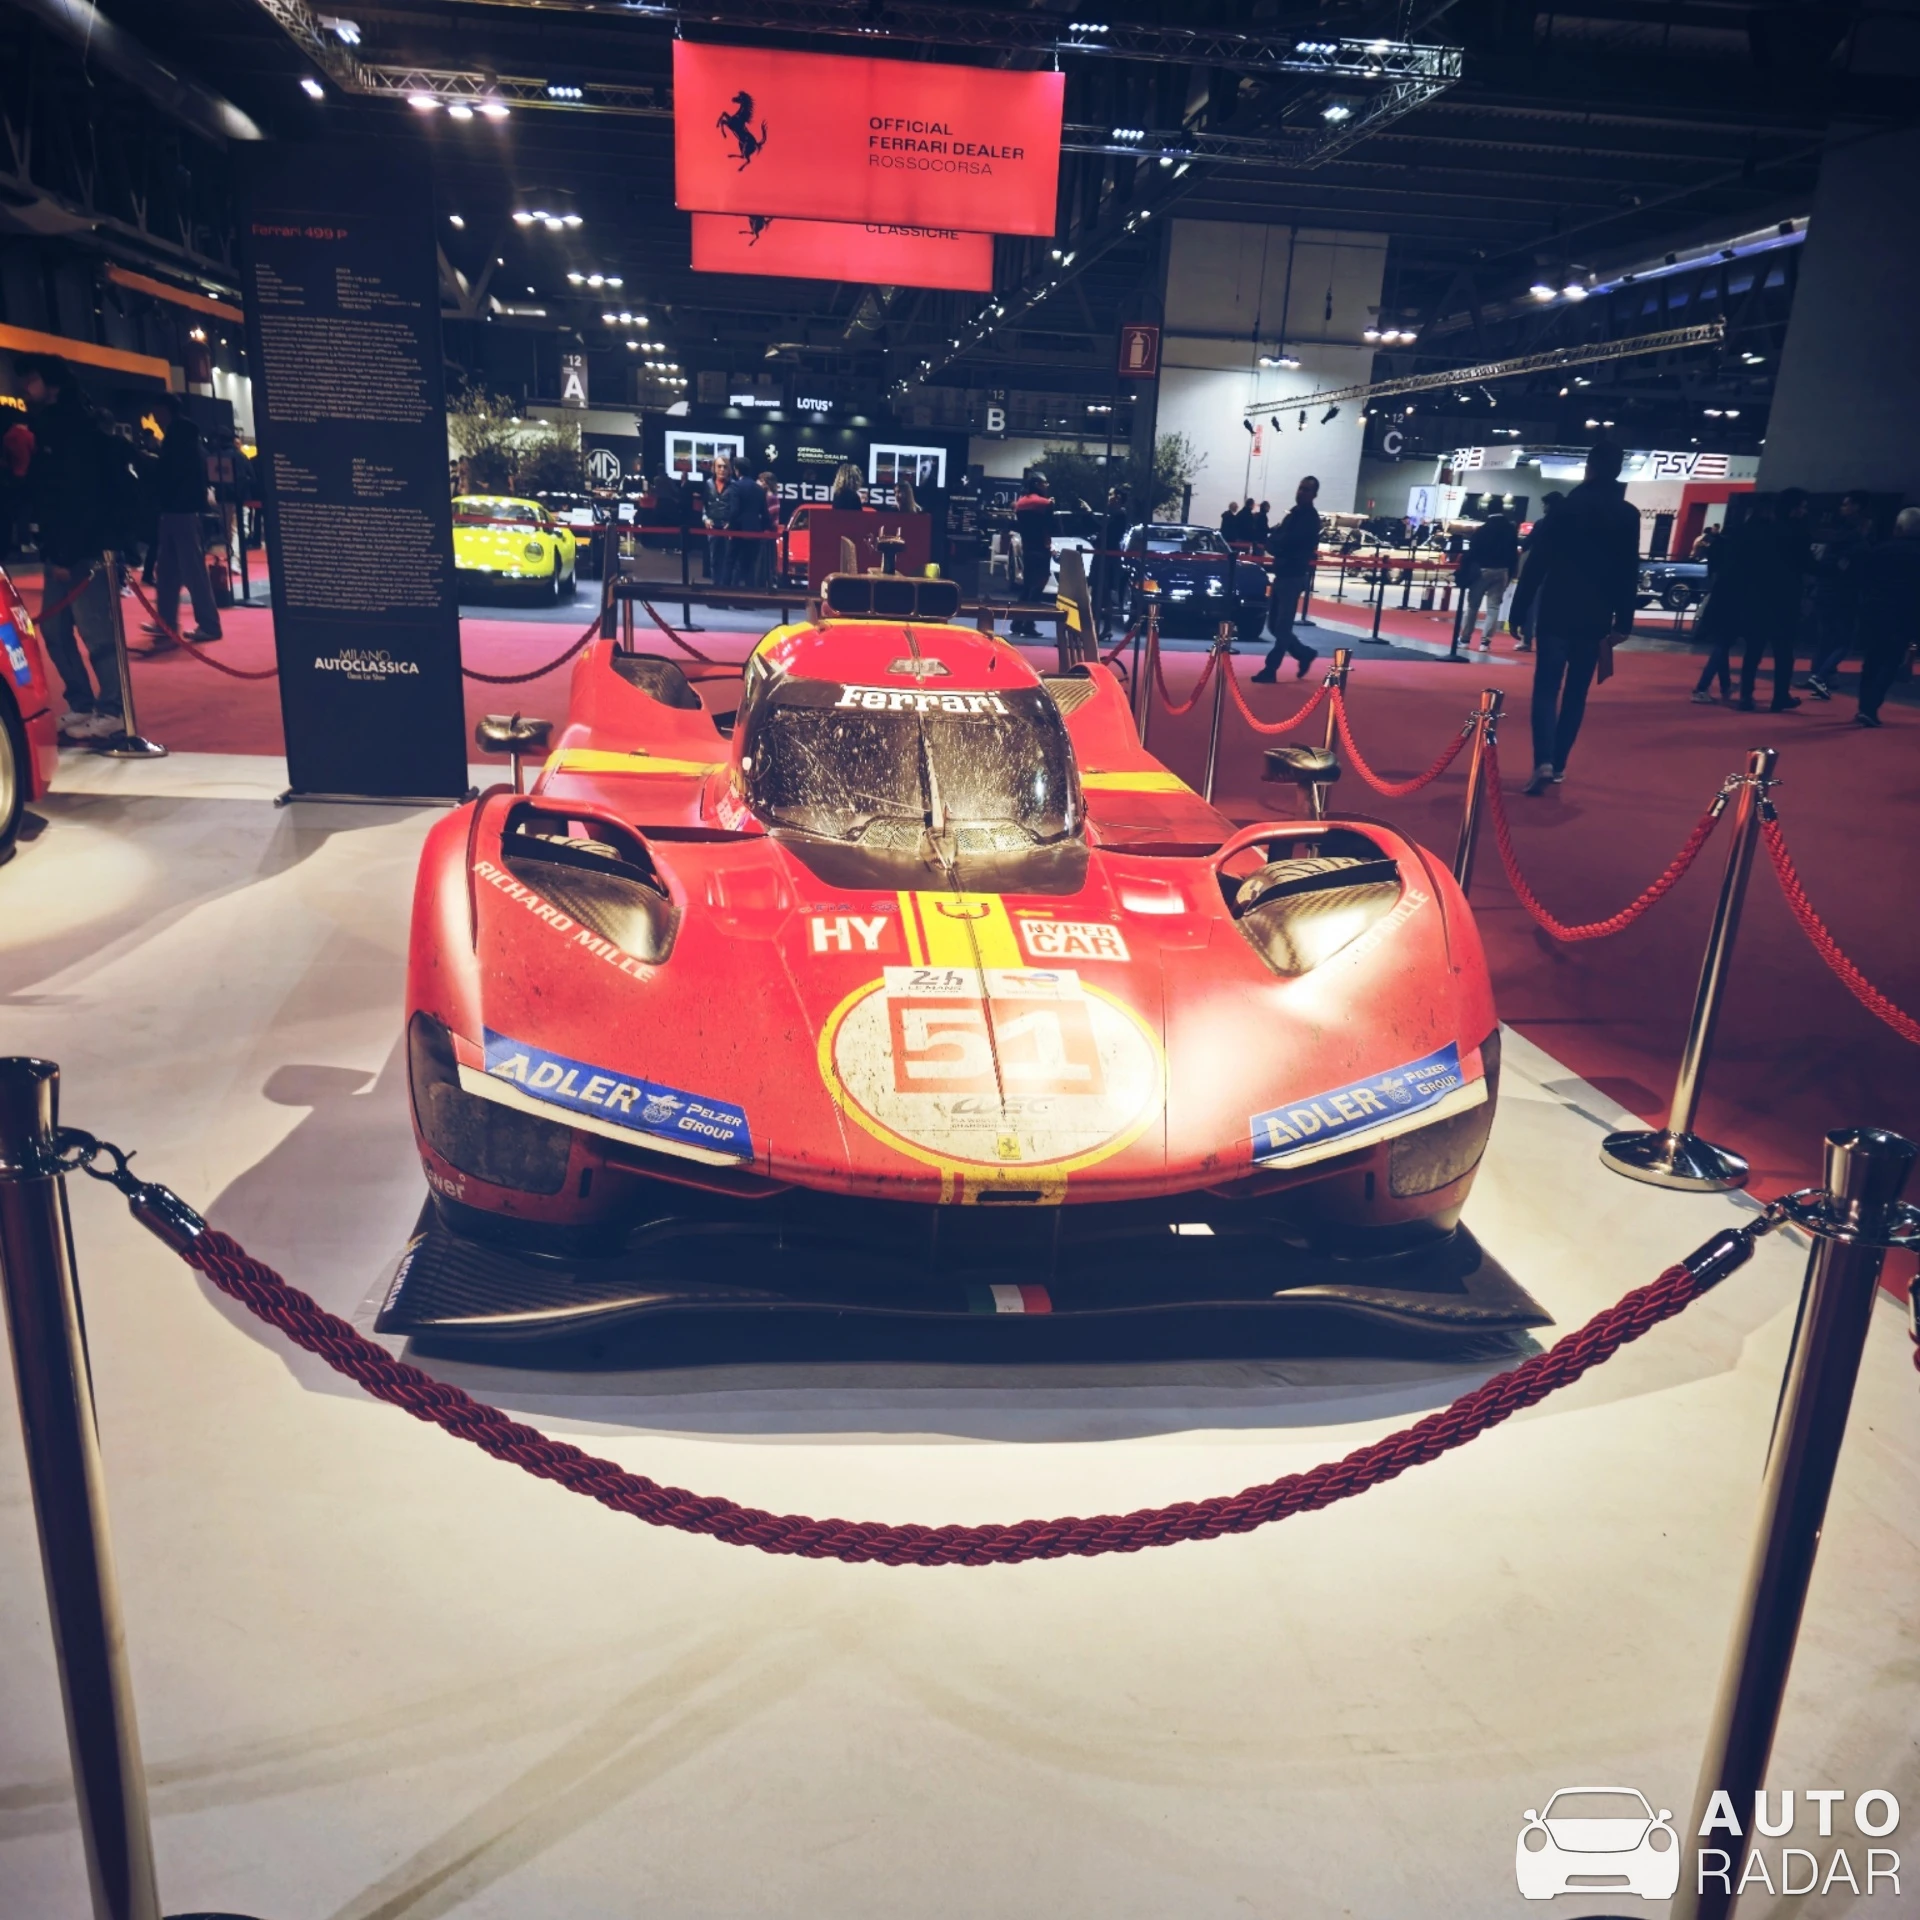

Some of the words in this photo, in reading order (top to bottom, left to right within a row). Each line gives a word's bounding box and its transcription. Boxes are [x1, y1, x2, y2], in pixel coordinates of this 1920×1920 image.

[869, 117, 953, 135] OFFICIAL
[869, 135, 948, 154] FERRARI
[953, 143, 1025, 160] DEALER
[869, 155, 993, 176] ROSSOCORSA
[252, 223, 302, 237] Ferrari
[305, 226, 334, 240] 499
[337, 228, 348, 239] P
[568, 355, 582, 367] 12
[563, 374, 586, 400] A
[993, 389, 1005, 400] 12
[797, 397, 829, 412] LOTUS
[987, 408, 1006, 431] B
[1393, 413, 1404, 423] 12
[1383, 431, 1404, 454] C
[587, 451, 618, 482] MG
[314, 657, 420, 674] AUTOCLASSICA
[339, 648, 391, 661] MILANO
[834, 685, 1009, 715] Ferrari
[473, 859, 572, 931] RICHARD
[574, 928, 656, 983] MILLE
[1026, 921, 1113, 938] HYPER
[810, 917, 888, 952] HY
[1032, 935, 1119, 958] CAR
[900, 1008, 1093, 1081] 51
[488, 1052, 642, 1114] ADLER
[685, 1102, 743, 1128] PELZER
[1417, 1074, 1458, 1096] GROUP
[1265, 1086, 1382, 1149] ADLER
[1403, 1062, 1447, 1084] PELZER
[677, 1116, 735, 1142] GROUP
[383, 1253, 415, 1313] MICHELIN
